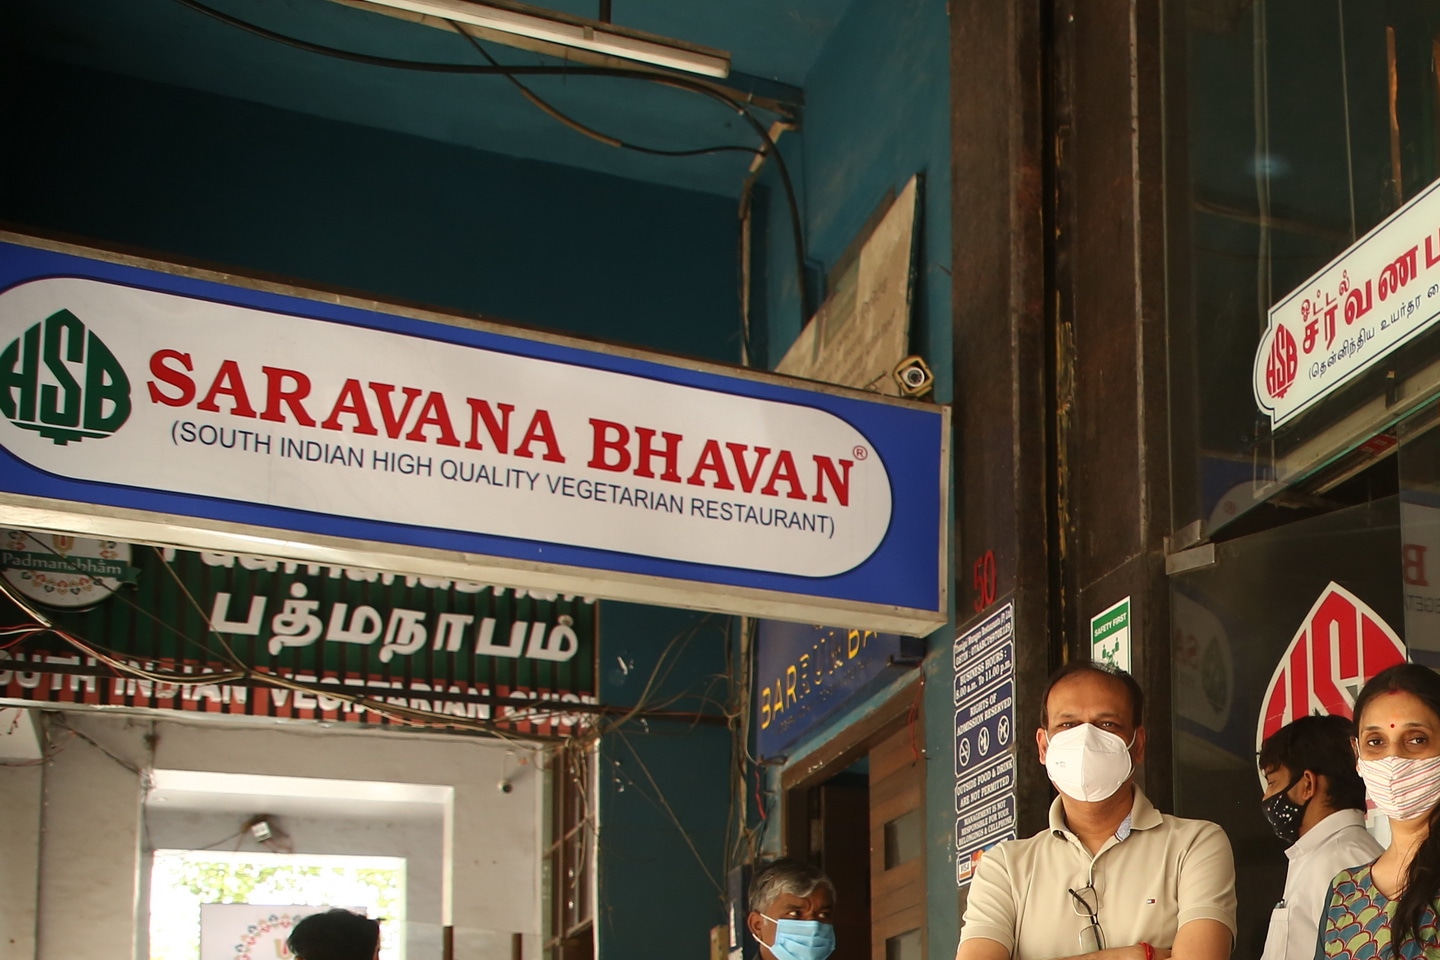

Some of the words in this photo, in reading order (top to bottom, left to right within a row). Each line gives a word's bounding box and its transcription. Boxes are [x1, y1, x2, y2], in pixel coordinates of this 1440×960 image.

[1300, 269, 1350, 323] ஓட்டல்
[1308, 327, 1375, 380] (தென்னிந்திய
[1380, 294, 1422, 331] உயர்தர
[0, 308, 132, 440] HSB
[1265, 322, 1298, 398] HSB
[146, 348, 566, 464] SARAVANA
[587, 417, 854, 507] BHAVAN
[171, 420, 271, 455] (SOUTH
[280, 437, 364, 468] INDIAN
[372, 450, 432, 477] HIGH
[440, 459, 540, 491] QUALITY
[546, 474, 684, 515] VEGETARIAN
[691, 497, 835, 539] RESTAURANT)
[209, 582, 581, 664] பத்மநாபம்
[1094, 620, 1113, 638] SAFETY
[1112, 612, 1128, 630] FIRST
[960, 662, 984, 685] BUSINESS
[985, 650, 1003, 669] HOURS
[978, 676, 984, 685] To
[985, 664, 999, 681] 11.00
[957, 713, 983, 736] ADMISSION
[984, 697, 1011, 720] RESERVED
[970, 698, 989, 716] RIGHTS
[989, 693, 997, 704] OF
[957, 778, 977, 796] OUTSIDE
[977, 771, 991, 785] FOOD
[997, 759, 1012, 775] DRINK
[960, 795, 969, 807] ARE
[971, 790, 980, 802] NOT
[981, 775, 1009, 797] PERMITTED
[961, 818, 987, 836] RESPONSIBLE
[998, 808, 1009, 818] YOUR
[964, 807, 991, 826] MANAGEMENT
[997, 800, 1006, 810] NOT
